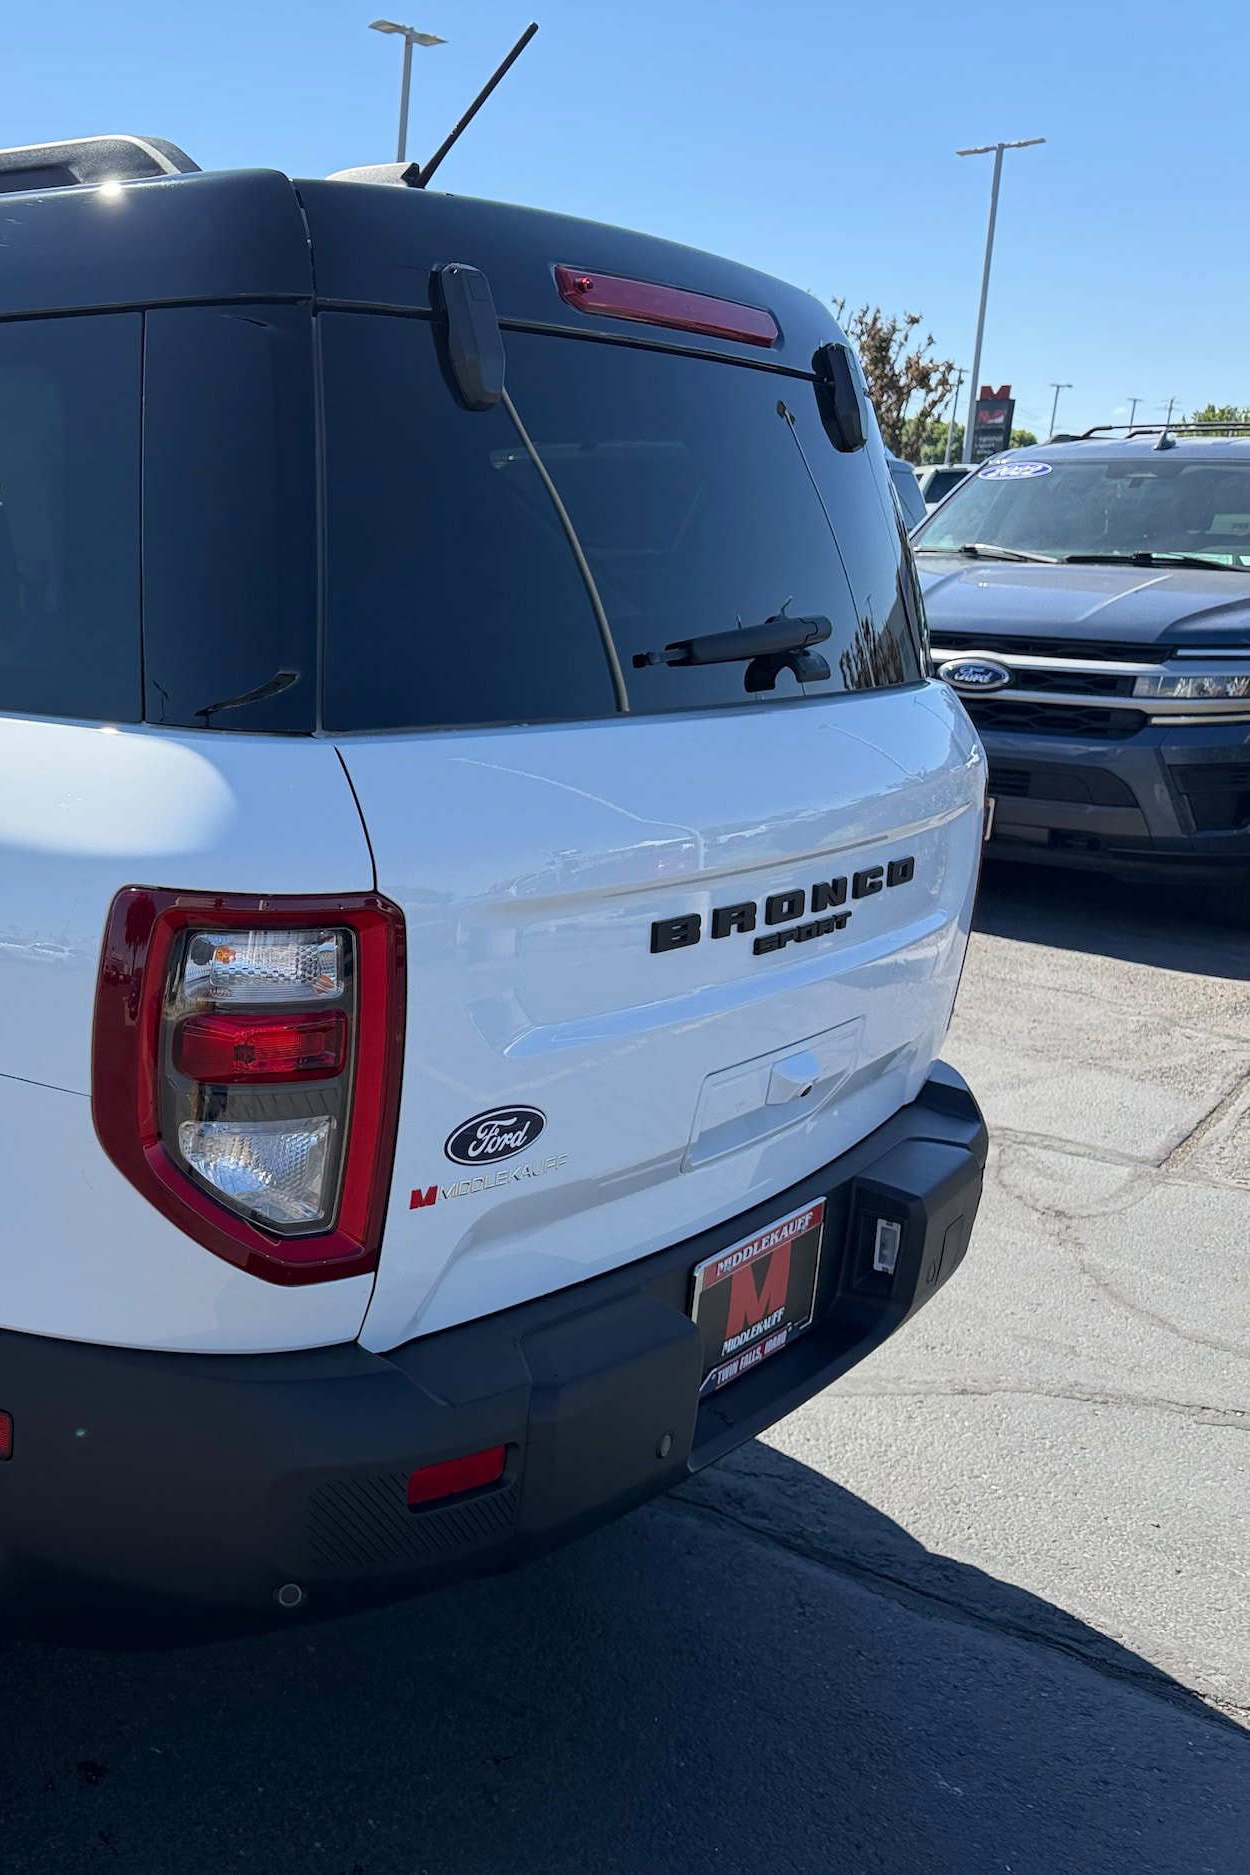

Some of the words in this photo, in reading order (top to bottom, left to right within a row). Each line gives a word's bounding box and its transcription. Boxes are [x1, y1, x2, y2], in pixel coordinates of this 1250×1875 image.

[954, 666, 992, 683] Ford
[650, 856, 915, 954] BRONCO
[753, 910, 853, 956] SPORT
[467, 1116, 531, 1158] Ford
[409, 1185, 438, 1210] M
[438, 1153, 569, 1201] MIDDLEKAUFF
[716, 1211, 814, 1277] MIDDLEKAUFF
[725, 1239, 792, 1339] M
[716, 1364, 738, 1384] TWIN
[738, 1347, 763, 1371] FALLS,
[764, 1330, 788, 1355] IDAHO
[721, 1306, 785, 1356] MIDDLEKAUFF
